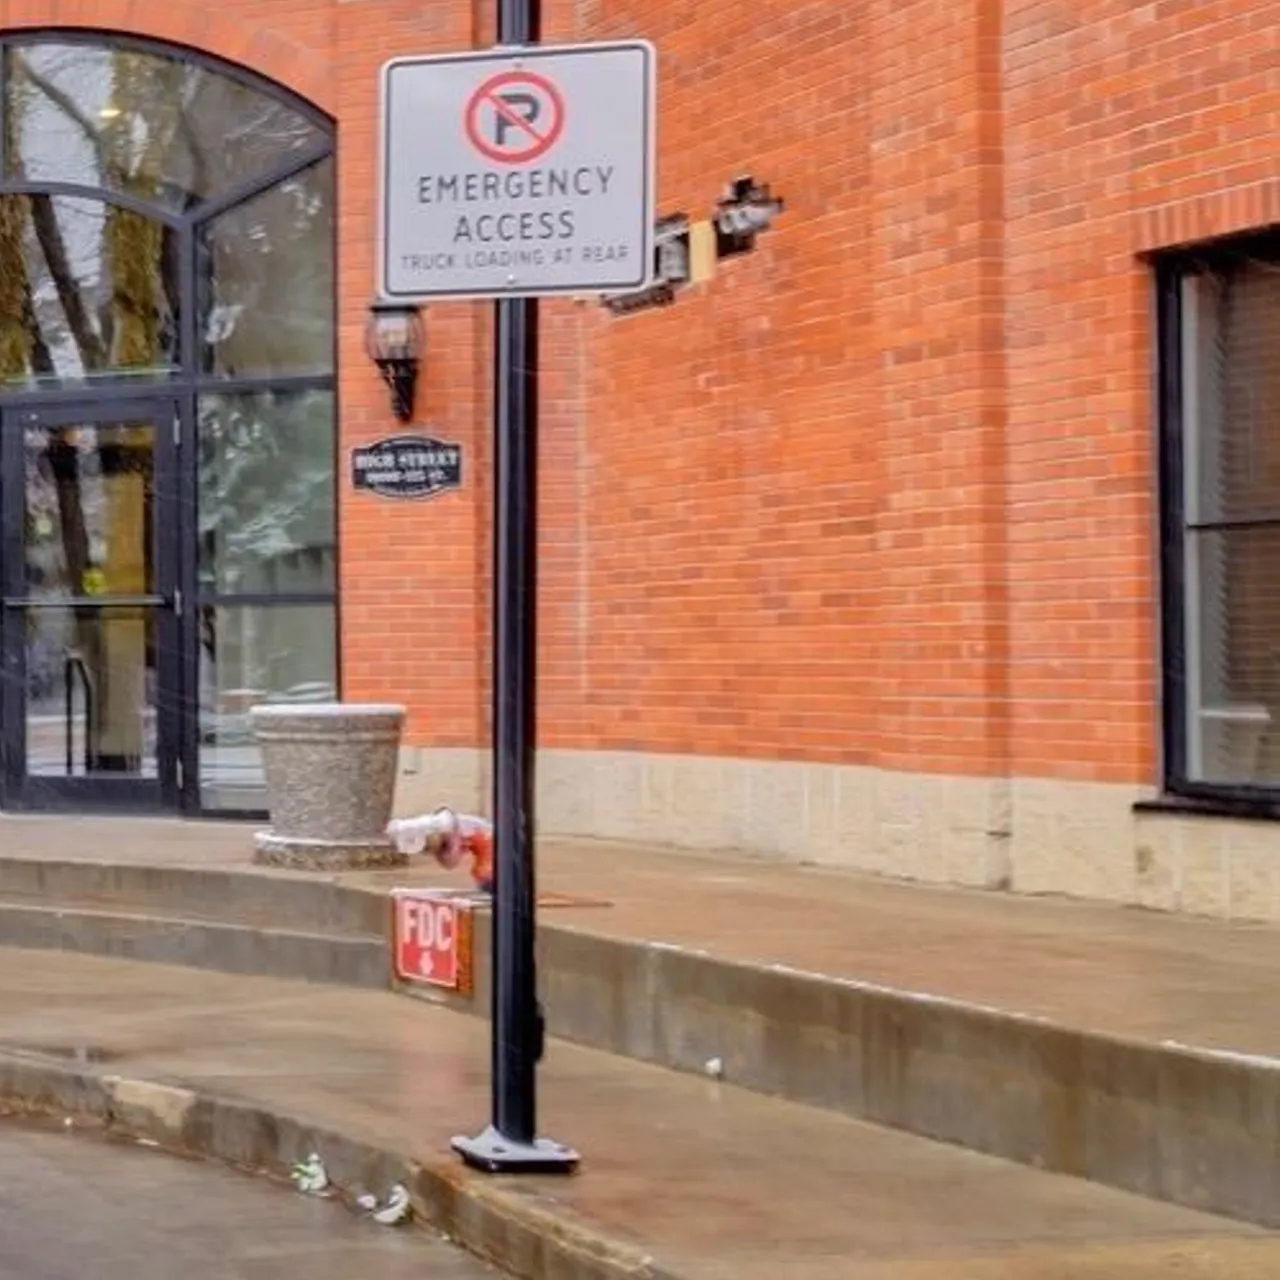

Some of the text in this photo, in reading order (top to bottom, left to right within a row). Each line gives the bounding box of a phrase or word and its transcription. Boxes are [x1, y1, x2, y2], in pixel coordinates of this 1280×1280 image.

[417, 166, 614, 203] EMERGENCY
[453, 211, 575, 243] ACCESS
[401, 245, 629, 272] TRUCK LOADING AT REAR
[401, 899, 454, 952] FDC
